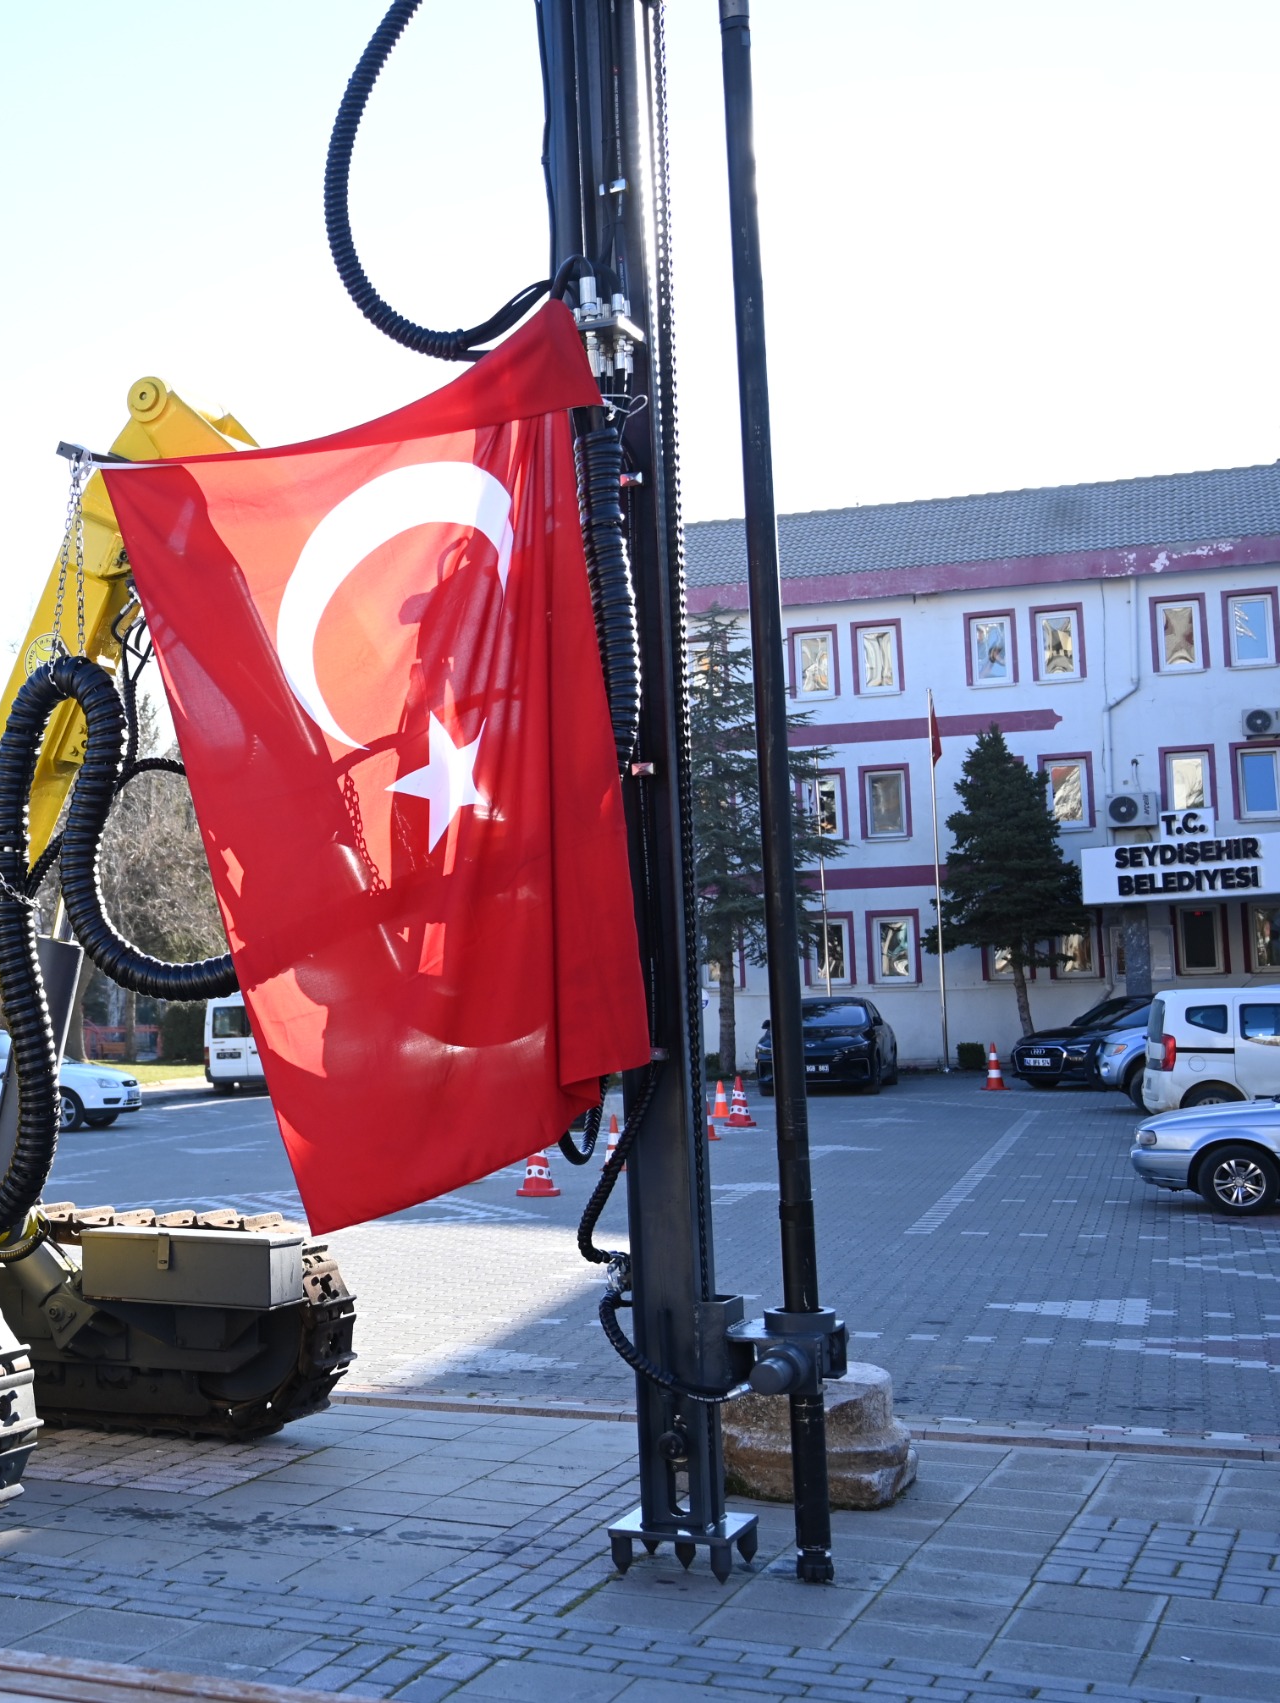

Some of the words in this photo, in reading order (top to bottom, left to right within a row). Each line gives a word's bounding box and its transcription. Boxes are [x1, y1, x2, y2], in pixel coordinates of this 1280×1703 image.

[1161, 812, 1208, 836] T.C.
[1115, 837, 1261, 869] SEYDİŞEHİR
[1118, 866, 1261, 896] BELEDİYESİ
